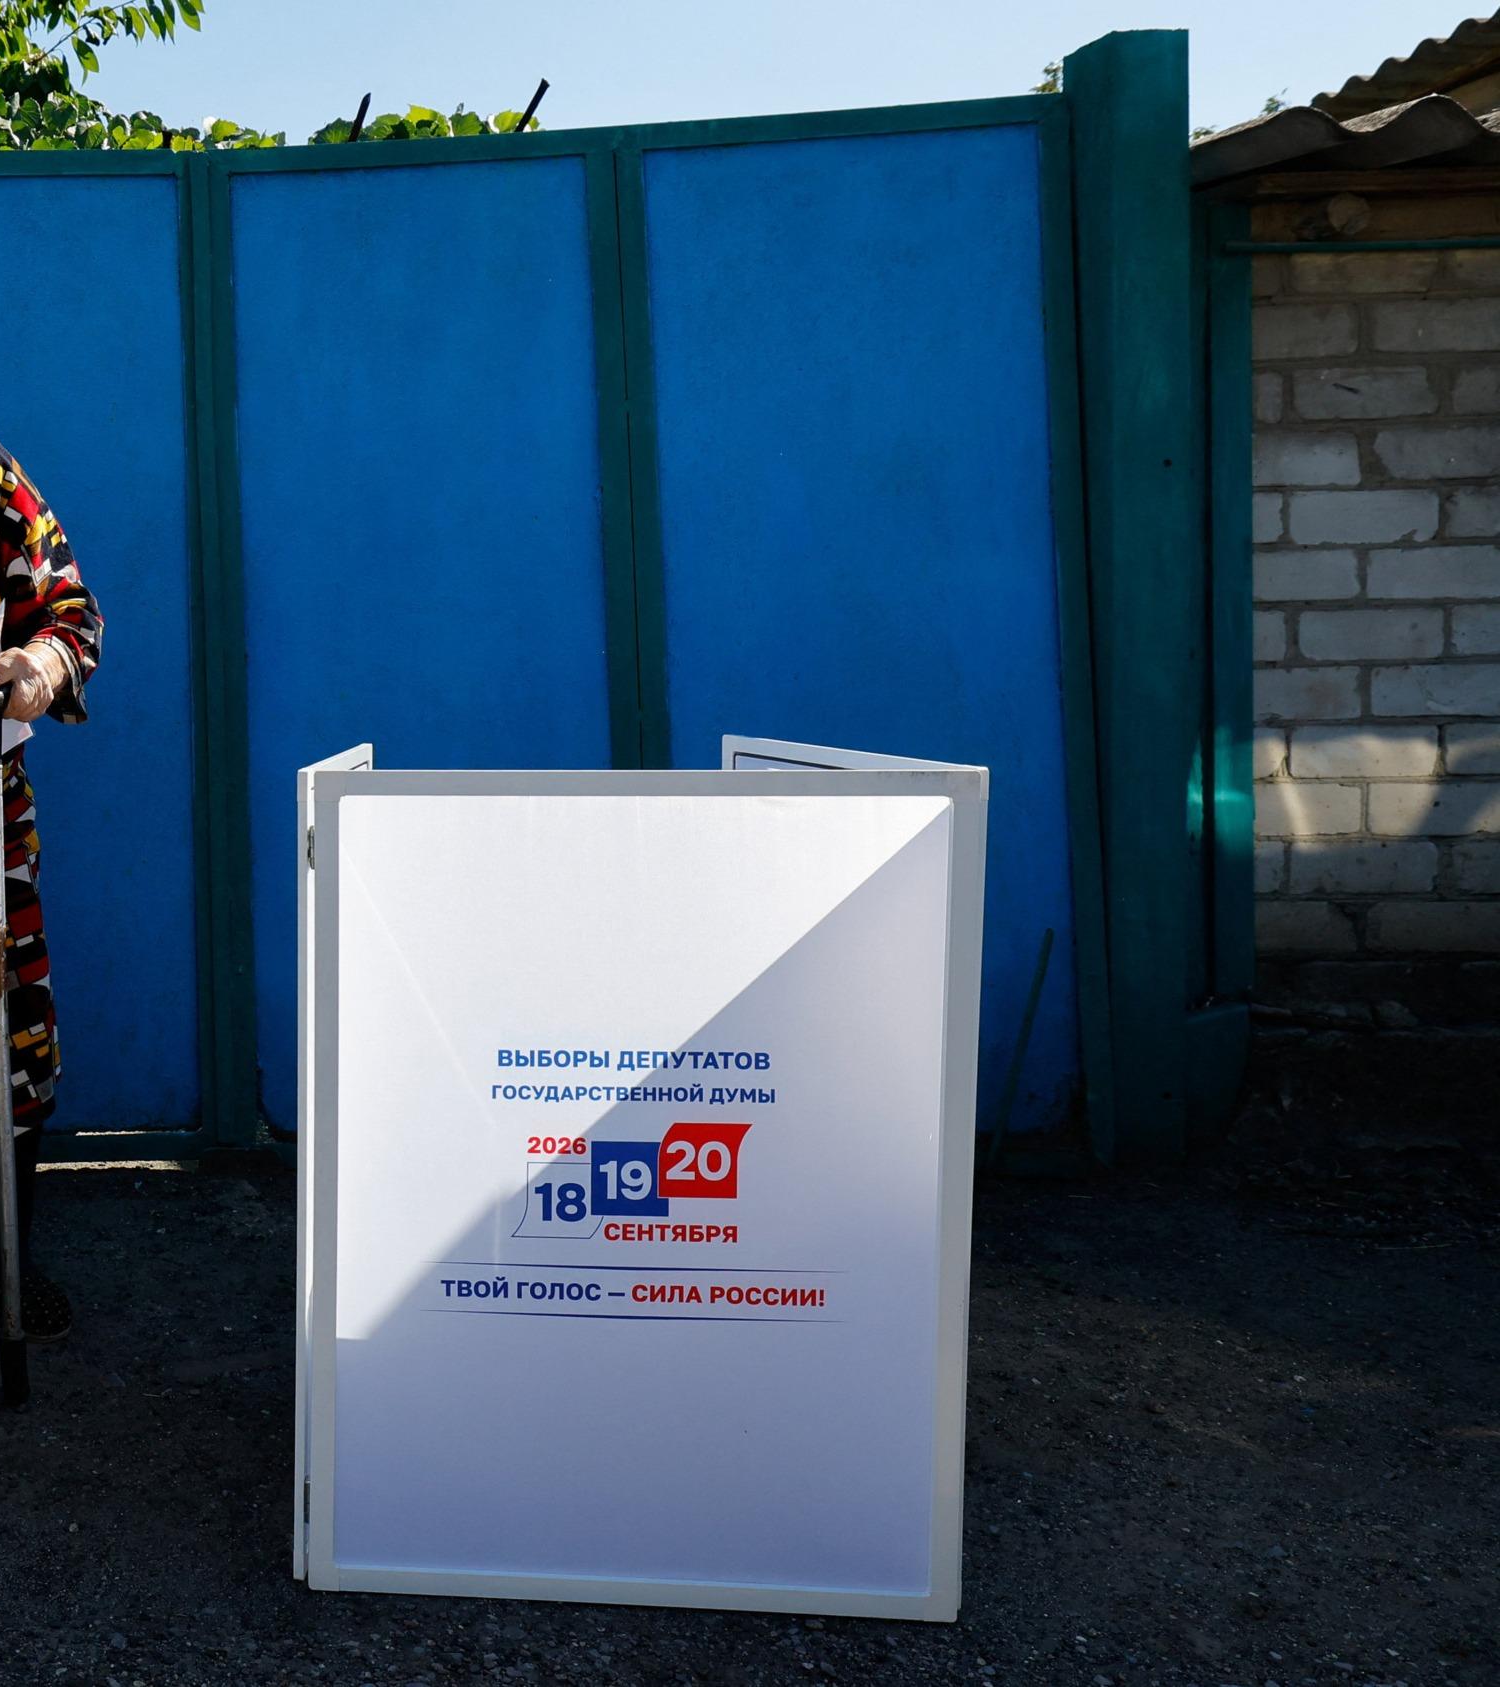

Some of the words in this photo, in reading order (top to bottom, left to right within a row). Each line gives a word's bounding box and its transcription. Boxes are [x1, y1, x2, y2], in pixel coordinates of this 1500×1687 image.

[498, 1049, 610, 1068] ВЫБОРЫ
[616, 1050, 771, 1071] ДЕПУТАТОВ
[491, 1084, 704, 1102] ГОСУДАРСТВЕННОЙ
[709, 1087, 776, 1105] ДУМЫ
[527, 1136, 587, 1155] 2026
[534, 1182, 587, 1222] 18
[599, 1160, 652, 1201] 19
[665, 1140, 731, 1182] 20
[603, 1223, 738, 1243] СЕНТЯБРЯ
[440, 1277, 509, 1299] ТВОЙ
[516, 1281, 602, 1301] ГОЛОС
[631, 1284, 703, 1304] СИЛА
[709, 1286, 826, 1308] РОССИИ!
